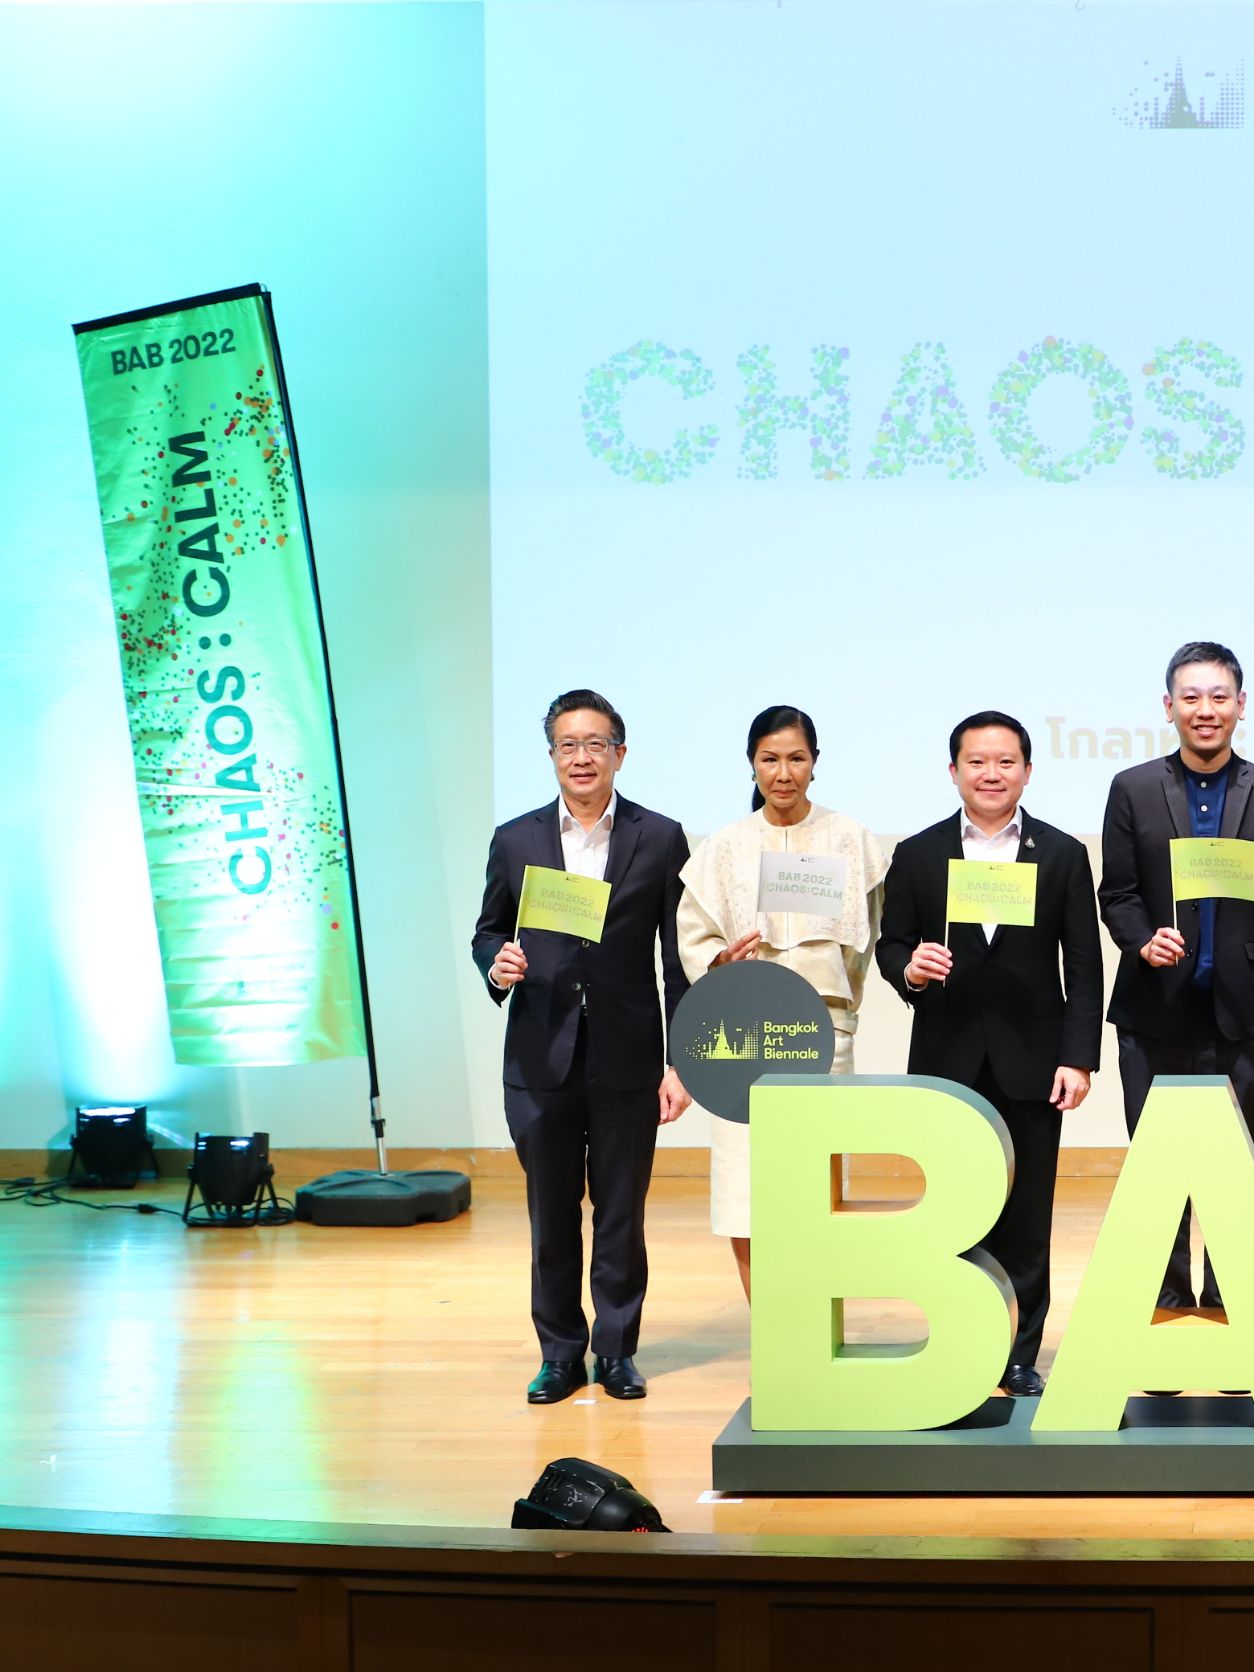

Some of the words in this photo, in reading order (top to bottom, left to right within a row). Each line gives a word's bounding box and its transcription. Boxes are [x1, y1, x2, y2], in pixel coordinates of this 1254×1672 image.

[111, 342, 165, 376] BAB
[168, 327, 236, 365] 2022
[1213, 858, 1244, 869] 2022
[778, 871, 801, 881] BAB
[802, 873, 833, 886] 2022
[766, 883, 842, 899] CHAOS:CALM
[991, 882, 1022, 893] 2022
[564, 893, 595, 908] 2022
[763, 1021, 819, 1036] Bangkok
[763, 1035, 784, 1047] Art
[763, 1047, 819, 1060] Biennale
